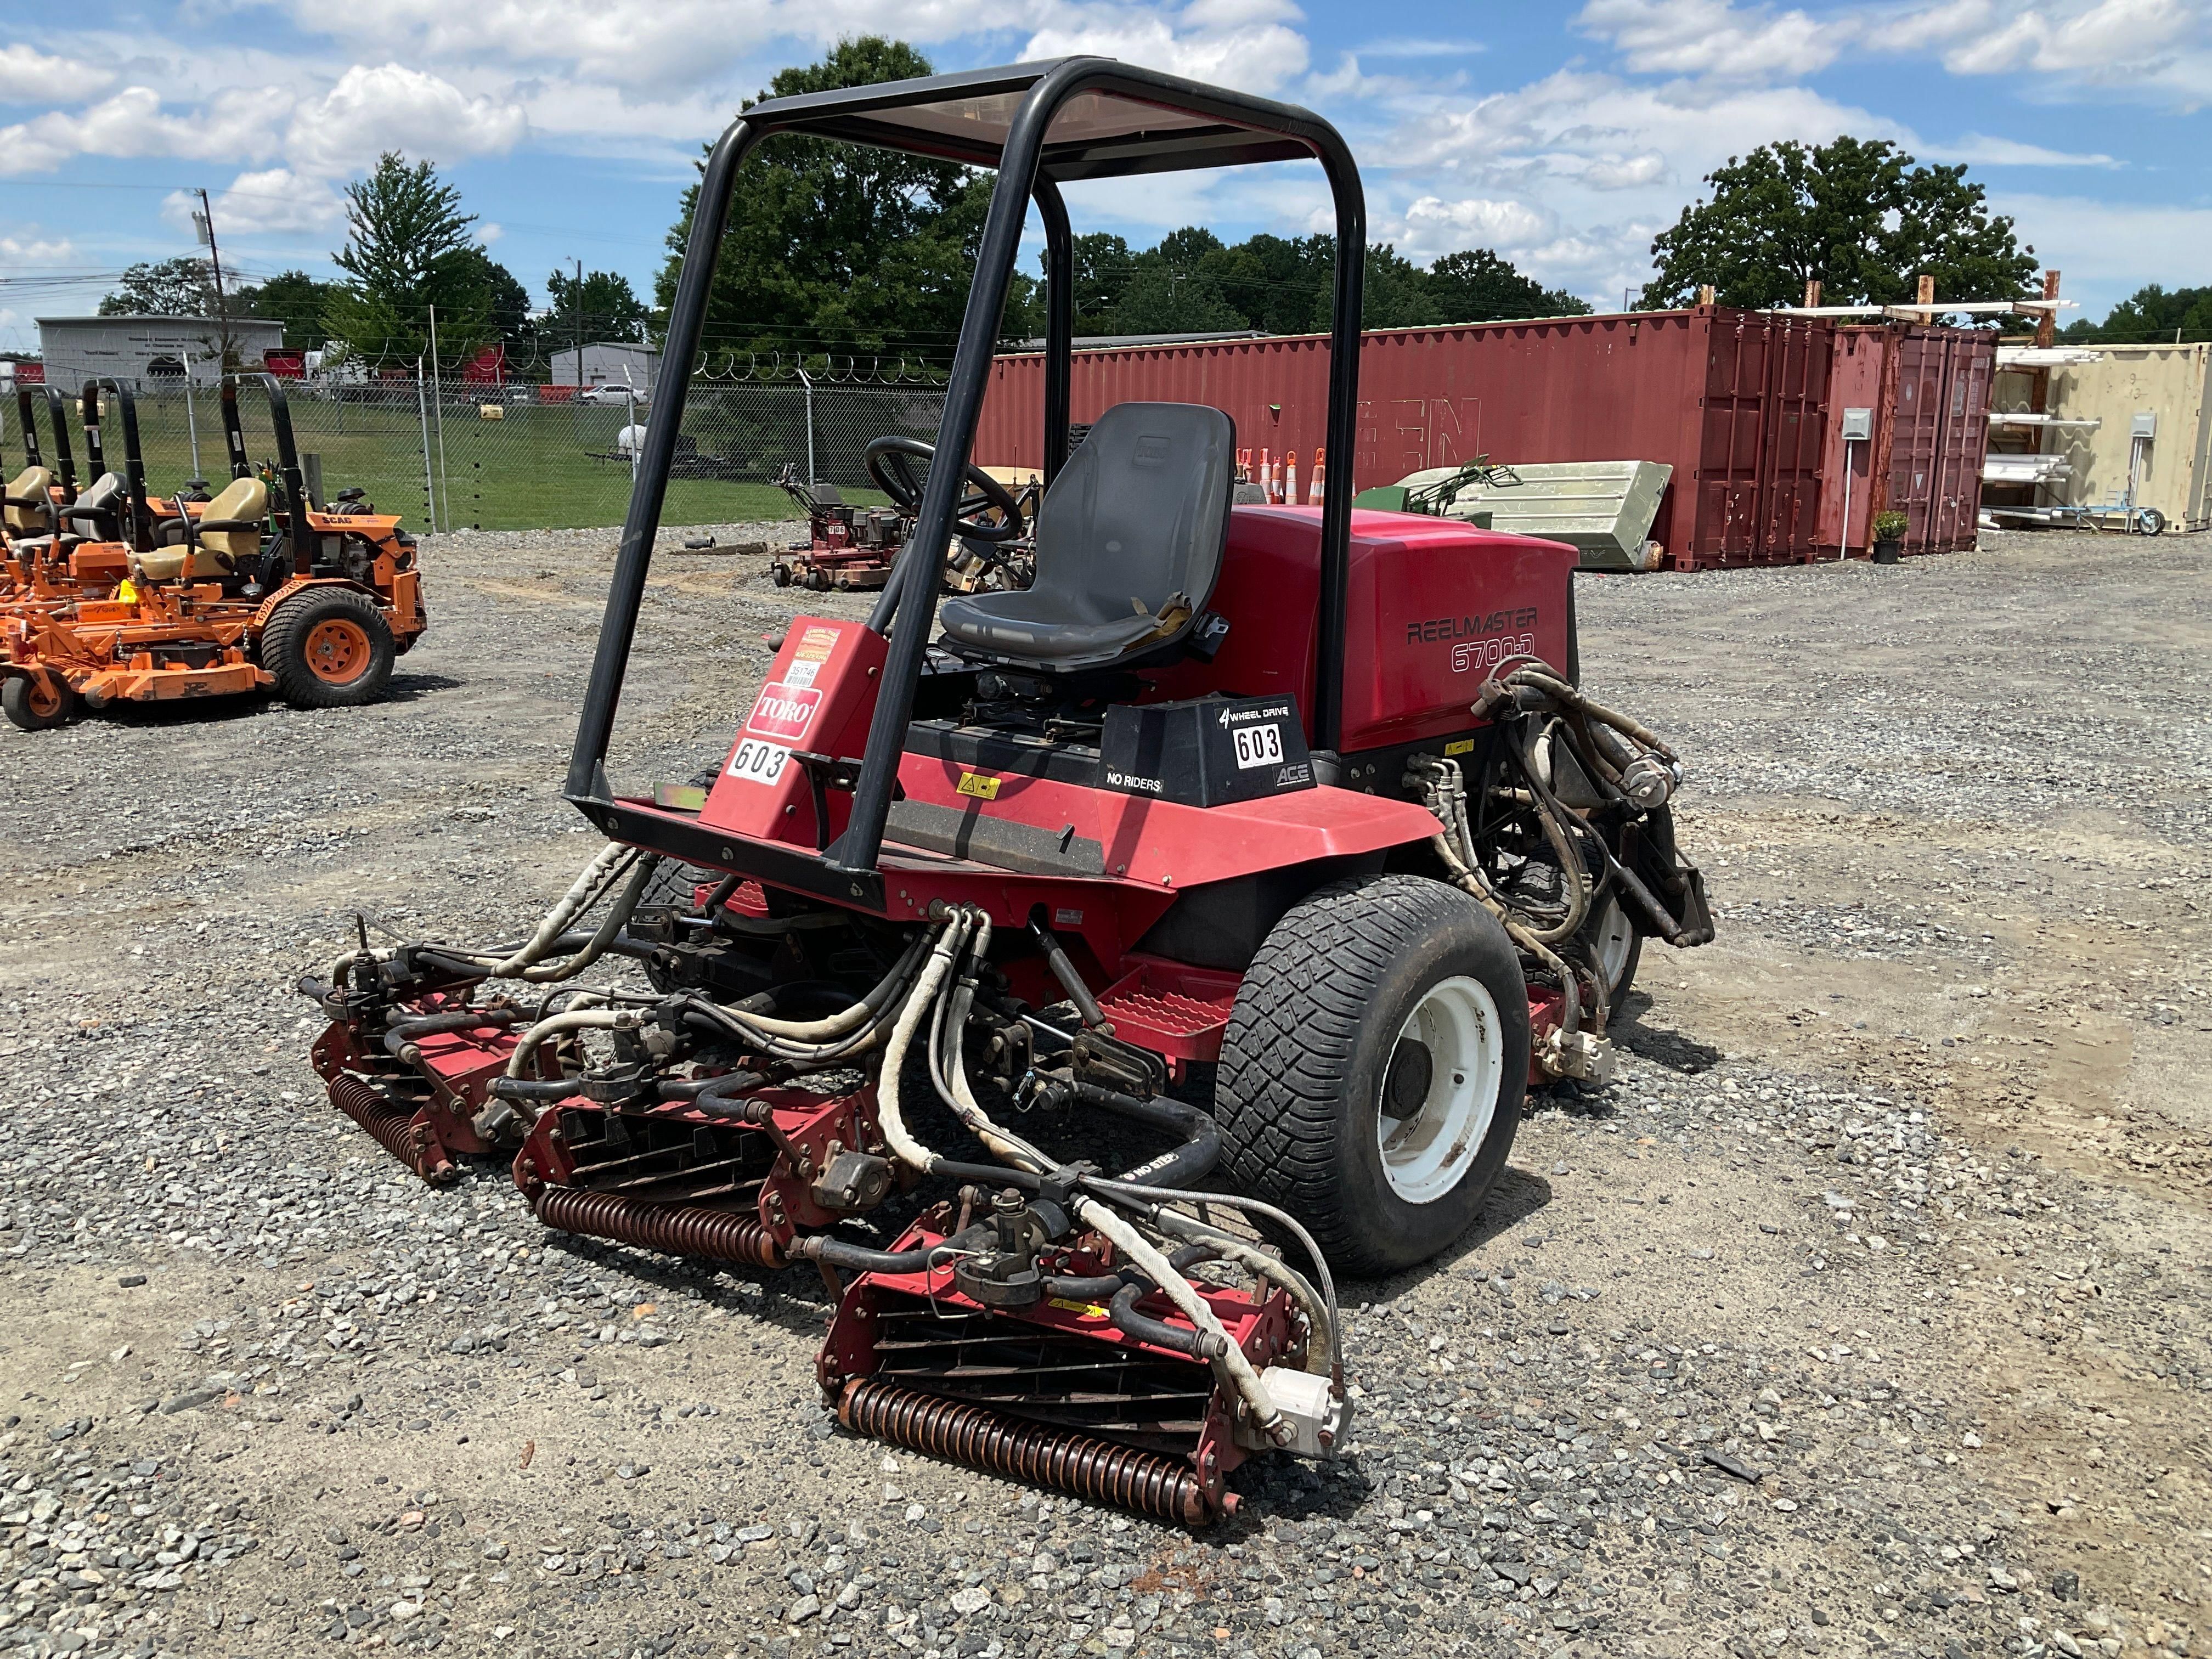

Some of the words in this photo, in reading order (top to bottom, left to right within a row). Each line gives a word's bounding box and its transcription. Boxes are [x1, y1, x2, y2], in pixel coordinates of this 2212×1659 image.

[1407, 607, 1538, 645] REELMASTER
[1452, 633, 1534, 672] 6700-D
[791, 667, 816, 677] 351746
[758, 696, 810, 723] TORO
[1218, 707, 1229, 729] 4
[1229, 710, 1262, 721] WHEEL
[1262, 707, 1289, 718] DRIVE
[1237, 729, 1279, 761] 603
[735, 743, 786, 778] 603
[1107, 772, 1122, 785] NO
[1124, 775, 1161, 792] RIDERS
[1277, 764, 1309, 783] ACE
[1133, 1165, 1152, 1177] NO
[1149, 1153, 1175, 1169] STEP
